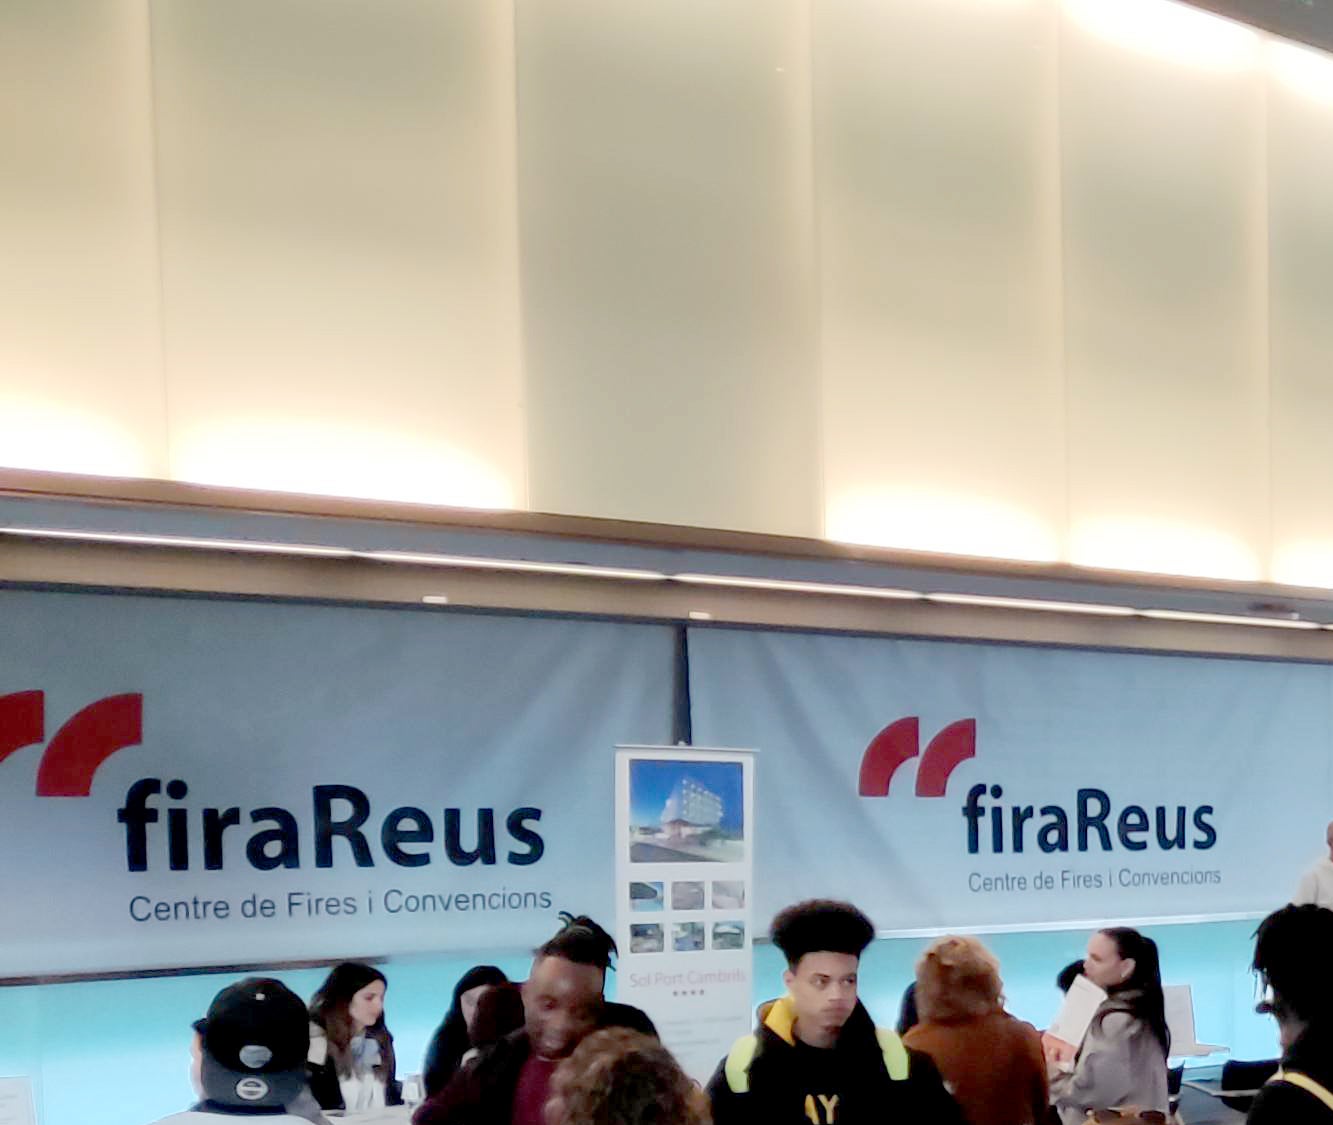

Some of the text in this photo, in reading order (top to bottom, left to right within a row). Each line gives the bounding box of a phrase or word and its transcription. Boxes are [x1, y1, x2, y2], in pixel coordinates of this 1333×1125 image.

[116, 777, 545, 873] firaReus
[961, 783, 1217, 854] firaReus
[128, 885, 552, 922] Centre de Fires i Convencions
[968, 867, 1221, 892] Centre de Fires i Convencions
